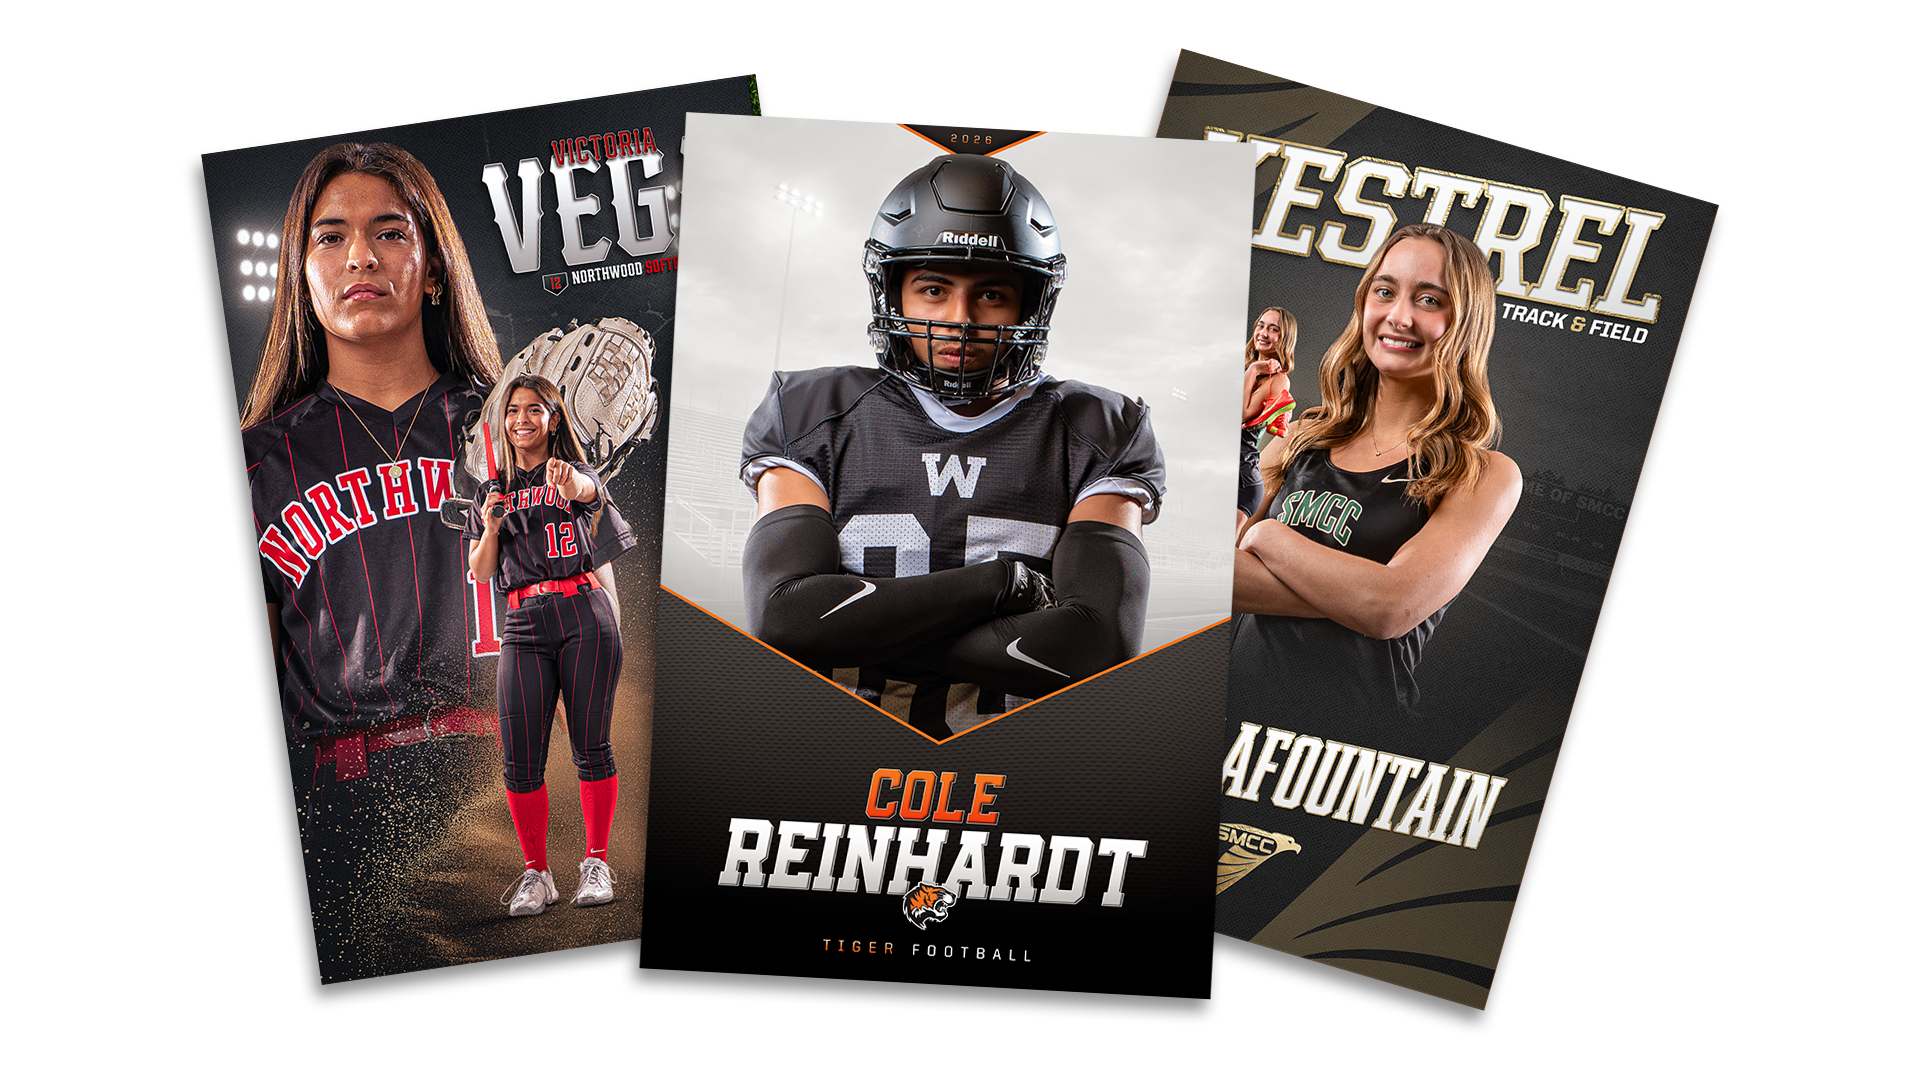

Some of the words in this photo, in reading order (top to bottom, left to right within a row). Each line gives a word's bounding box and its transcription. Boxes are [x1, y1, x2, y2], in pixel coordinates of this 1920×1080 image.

[551, 127, 658, 166] VICTORIA
[951, 133, 992, 145] 2026
[482, 136, 686, 274] VEG
[942, 232, 998, 248] Riddell
[1204, 126, 1666, 324] ESTREL
[550, 276, 562, 290] 12
[572, 262, 643, 284] NORTHWOOD
[1501, 302, 1566, 331] TRACK
[1570, 318, 1586, 333] &
[1589, 322, 1649, 345] FIELD
[922, 453, 987, 499] W
[1277, 490, 1363, 547] SMCC
[1550, 487, 1573, 505] OF
[1576, 496, 1626, 520] SMCC
[545, 522, 578, 558] 12
[866, 768, 1007, 825] COLE
[1222, 719, 1509, 849] AFOUNTAIN
[1219, 826, 1275, 854] SMCC
[718, 818, 1148, 907] REINHARDT
[822, 938, 895, 955] TIGER
[911, 943, 1032, 963] FOOTBALL
